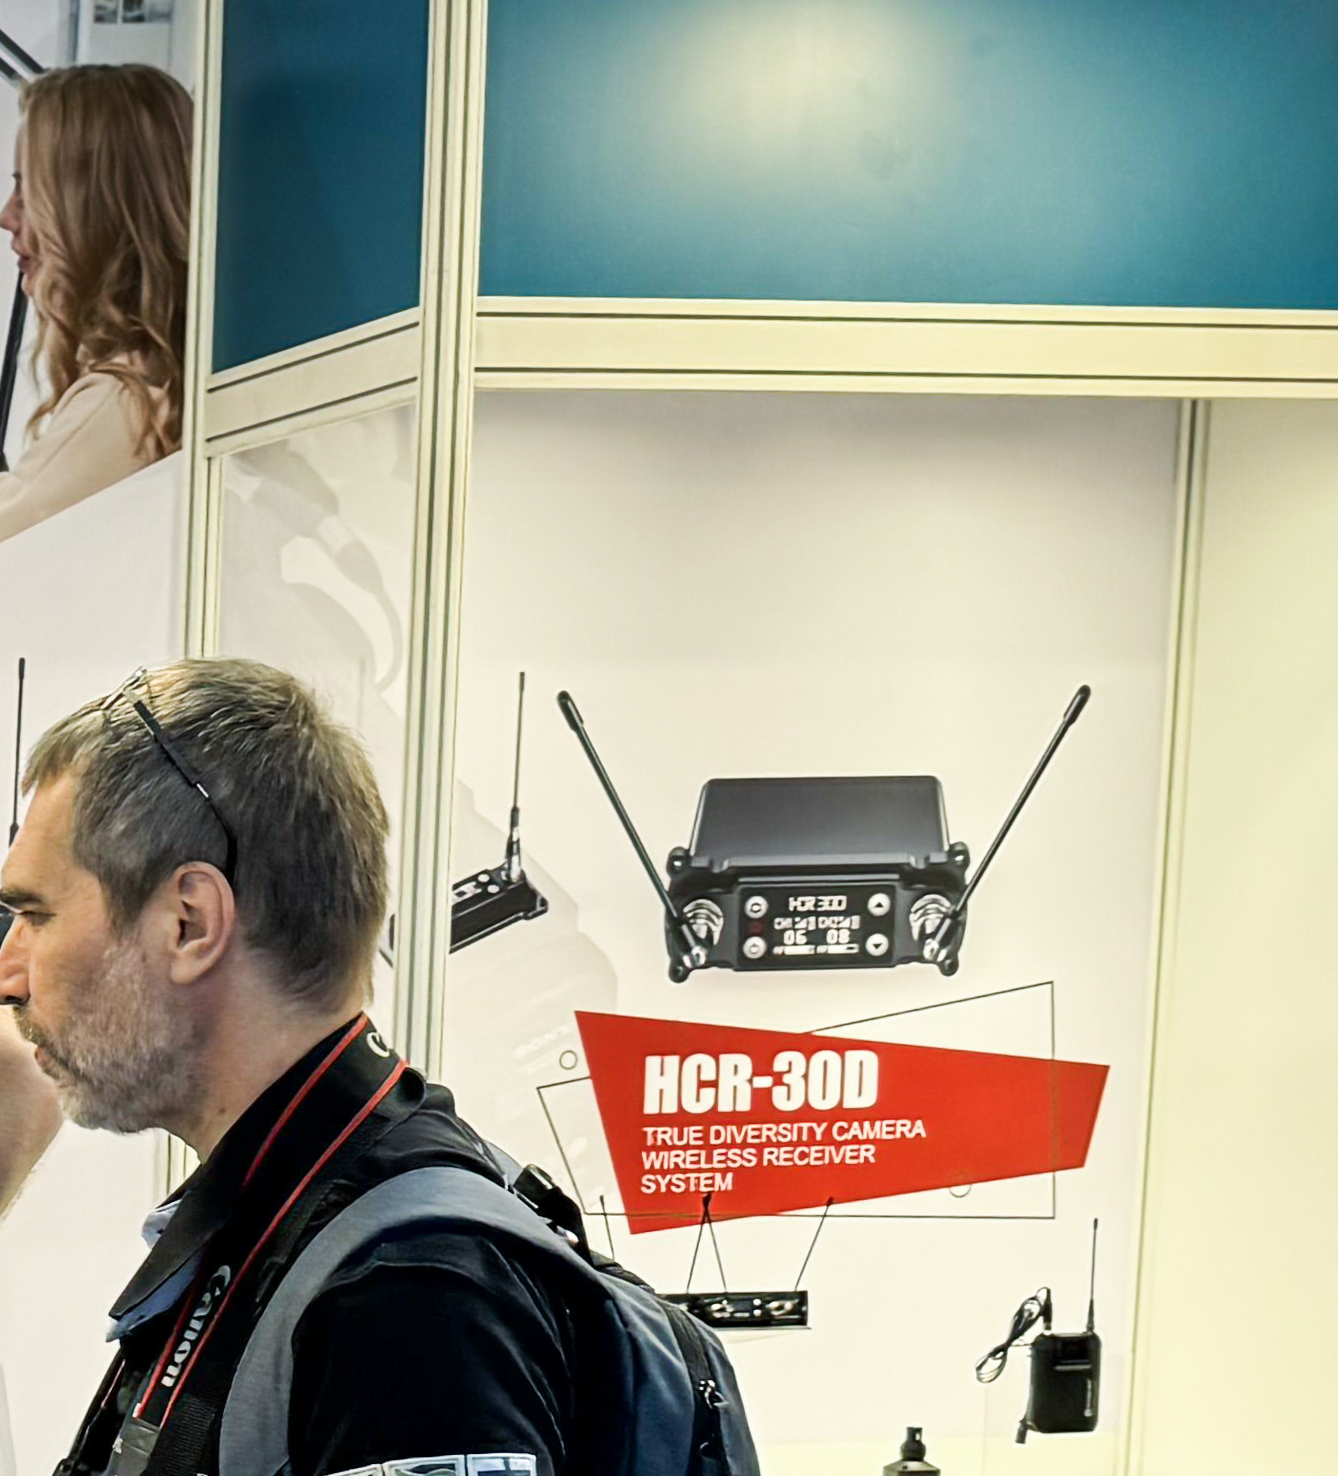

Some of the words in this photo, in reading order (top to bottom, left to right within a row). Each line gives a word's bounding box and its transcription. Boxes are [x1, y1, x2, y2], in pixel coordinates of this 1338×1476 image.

[643, 1050, 879, 1114] HCR-30D
[643, 1125, 704, 1146] TRUE
[710, 1121, 827, 1146] DIVERSITY
[832, 1119, 926, 1142] CAMERA
[641, 1148, 757, 1170] WIRELESS
[763, 1144, 875, 1167] RECEIVER
[641, 1172, 733, 1195] SYSTEM
[162, 1265, 231, 1387] Canon
